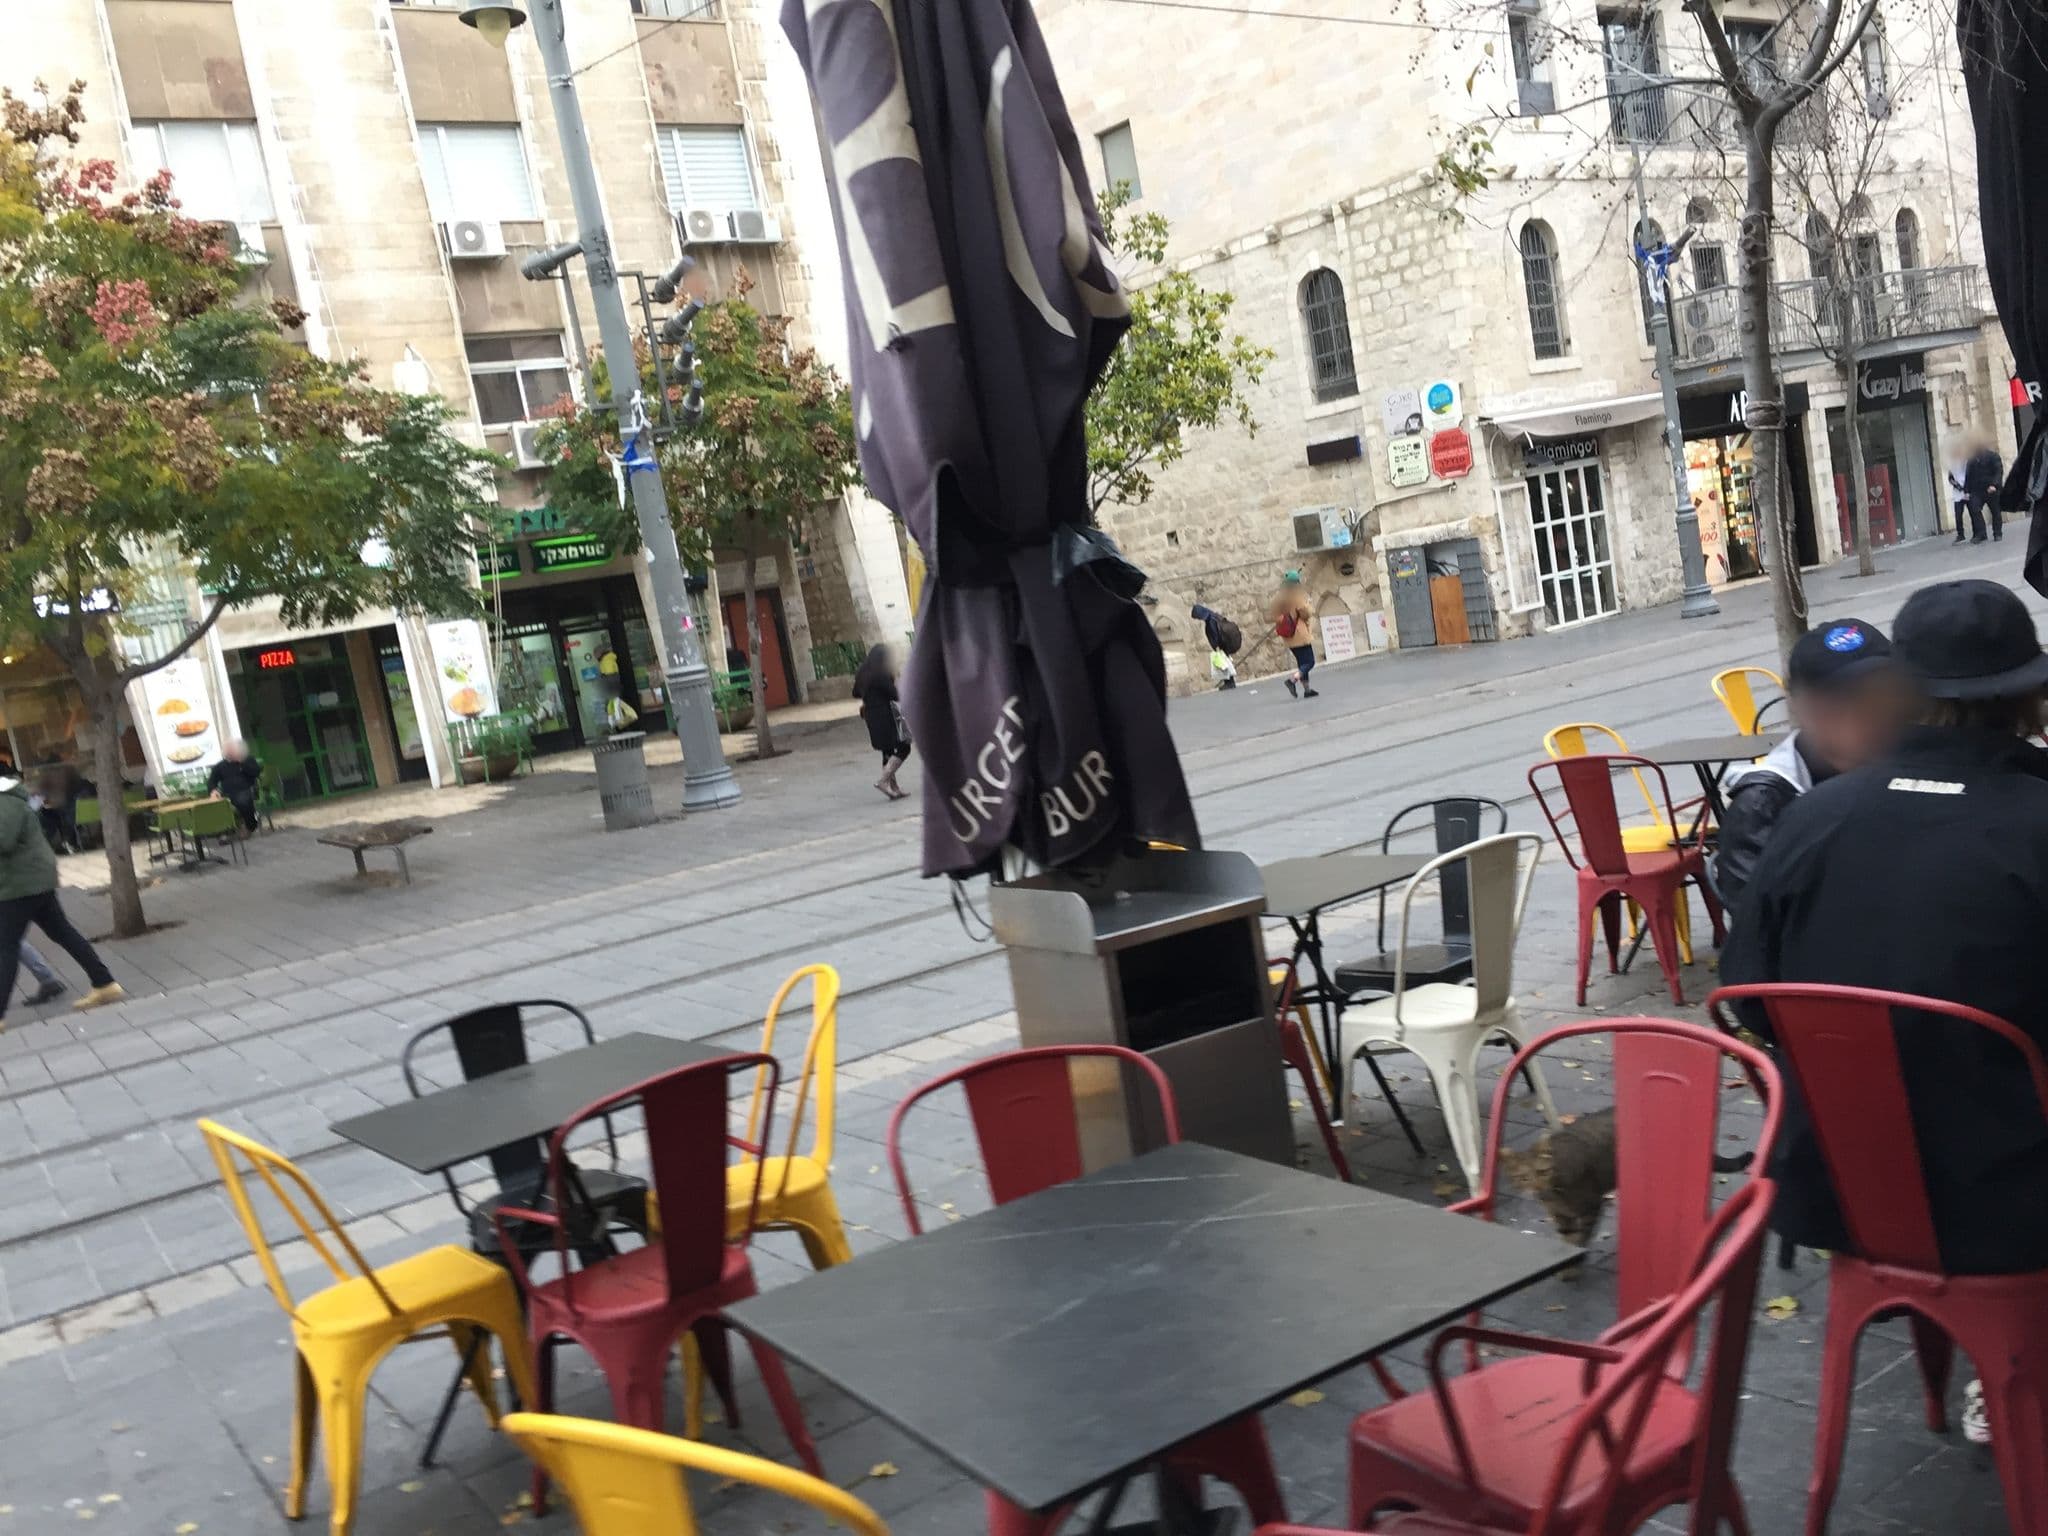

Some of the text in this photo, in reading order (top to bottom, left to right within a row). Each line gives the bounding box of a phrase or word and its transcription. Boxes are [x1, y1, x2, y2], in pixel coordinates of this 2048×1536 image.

[1860, 367, 1900, 399] Crazy
[1574, 412, 1612, 426] Flamingo
[260, 650, 294, 668] PIZZA
